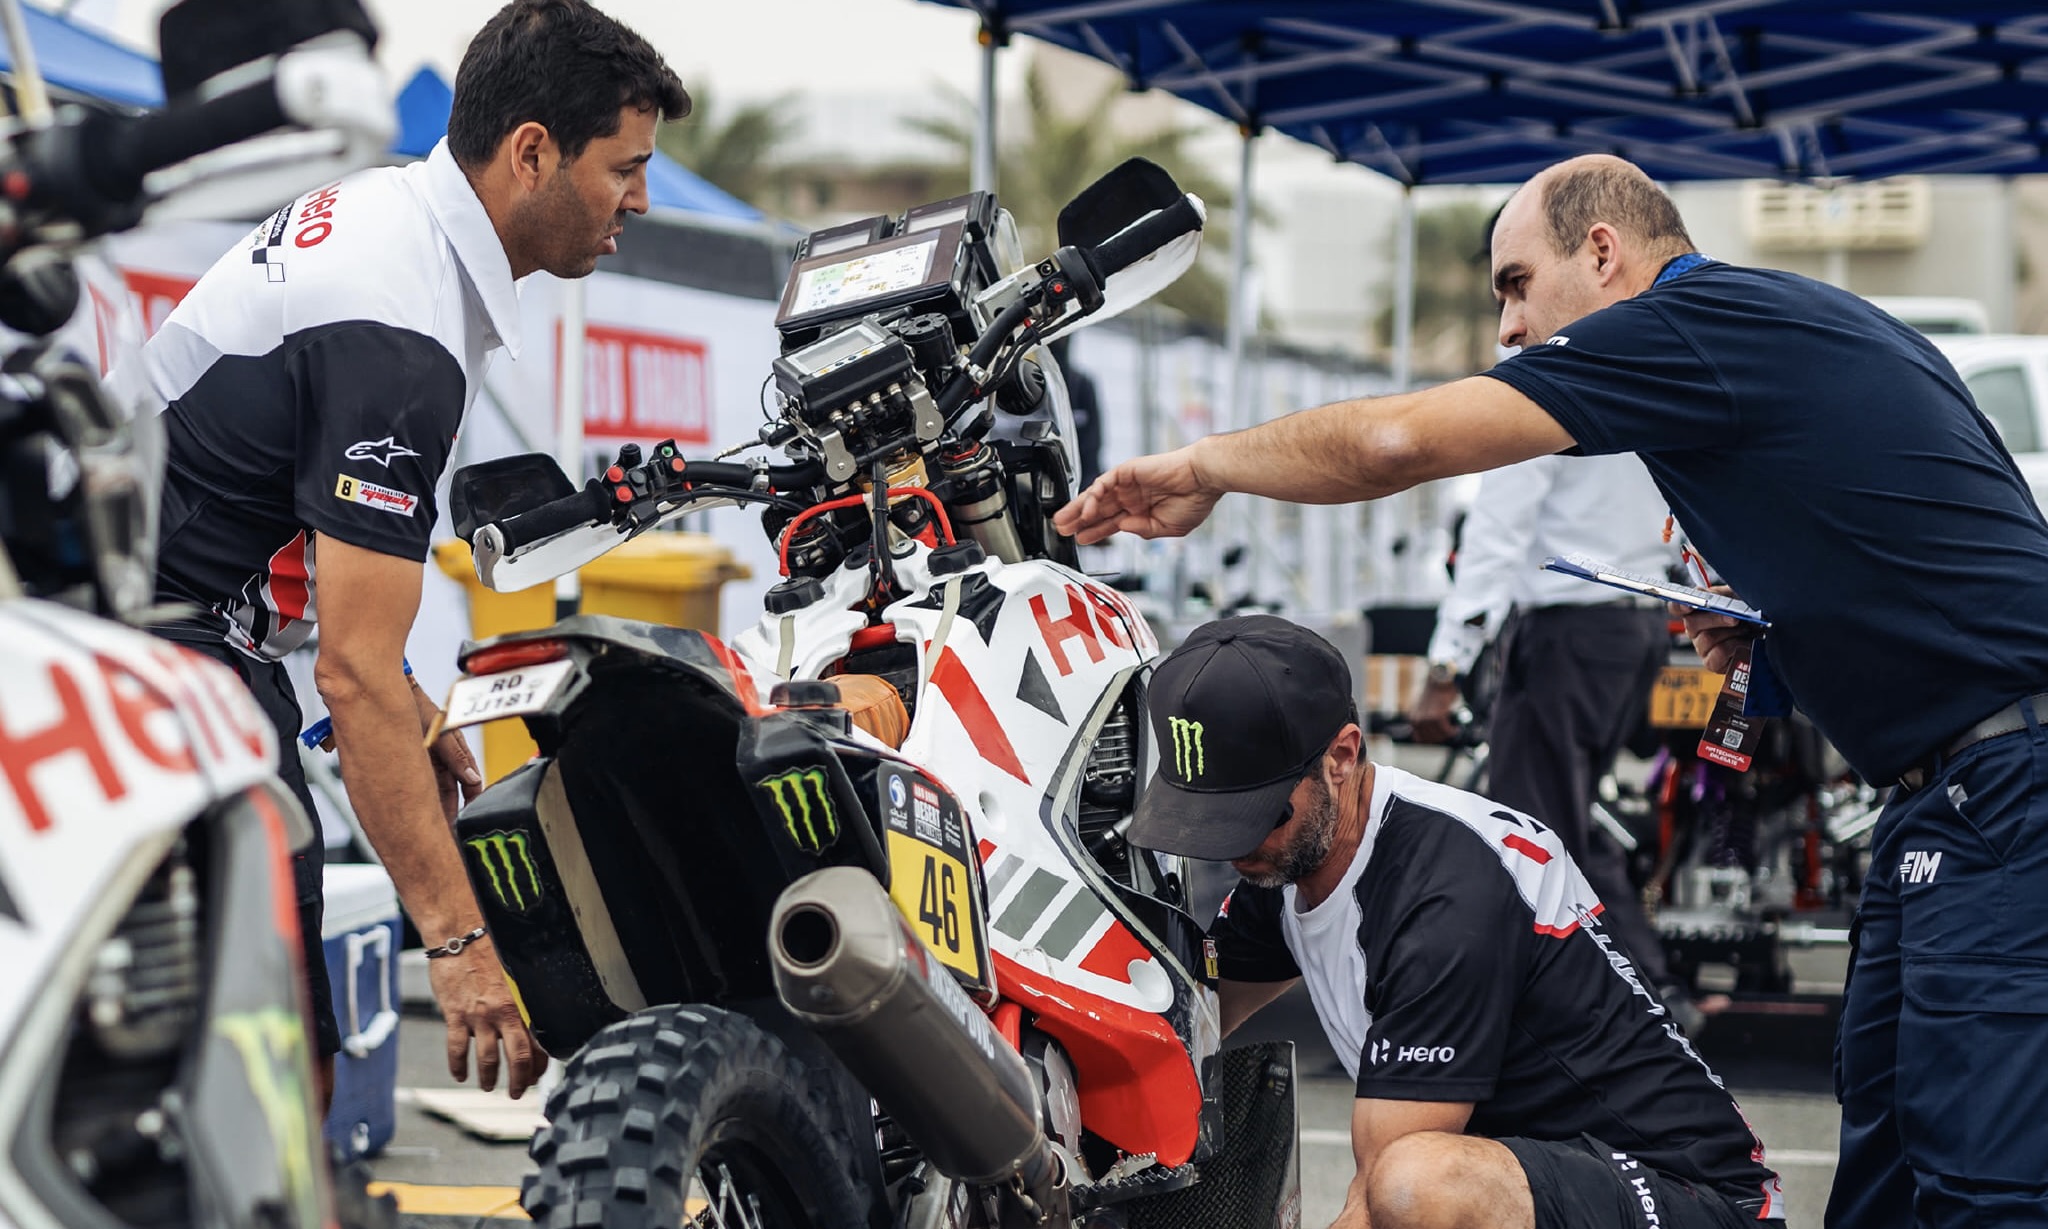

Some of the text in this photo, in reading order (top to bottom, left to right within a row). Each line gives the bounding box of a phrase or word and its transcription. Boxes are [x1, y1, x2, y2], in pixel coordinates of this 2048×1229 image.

[295, 182, 342, 248] Hero
[341, 480, 352, 497] 8
[1709, 752, 1737, 766] DELEGATE
[1899, 851, 1943, 884] FIM
[919, 854, 960, 955] 46
[1397, 1045, 1455, 1063] Hero
[1631, 1177, 1660, 1229] Her
